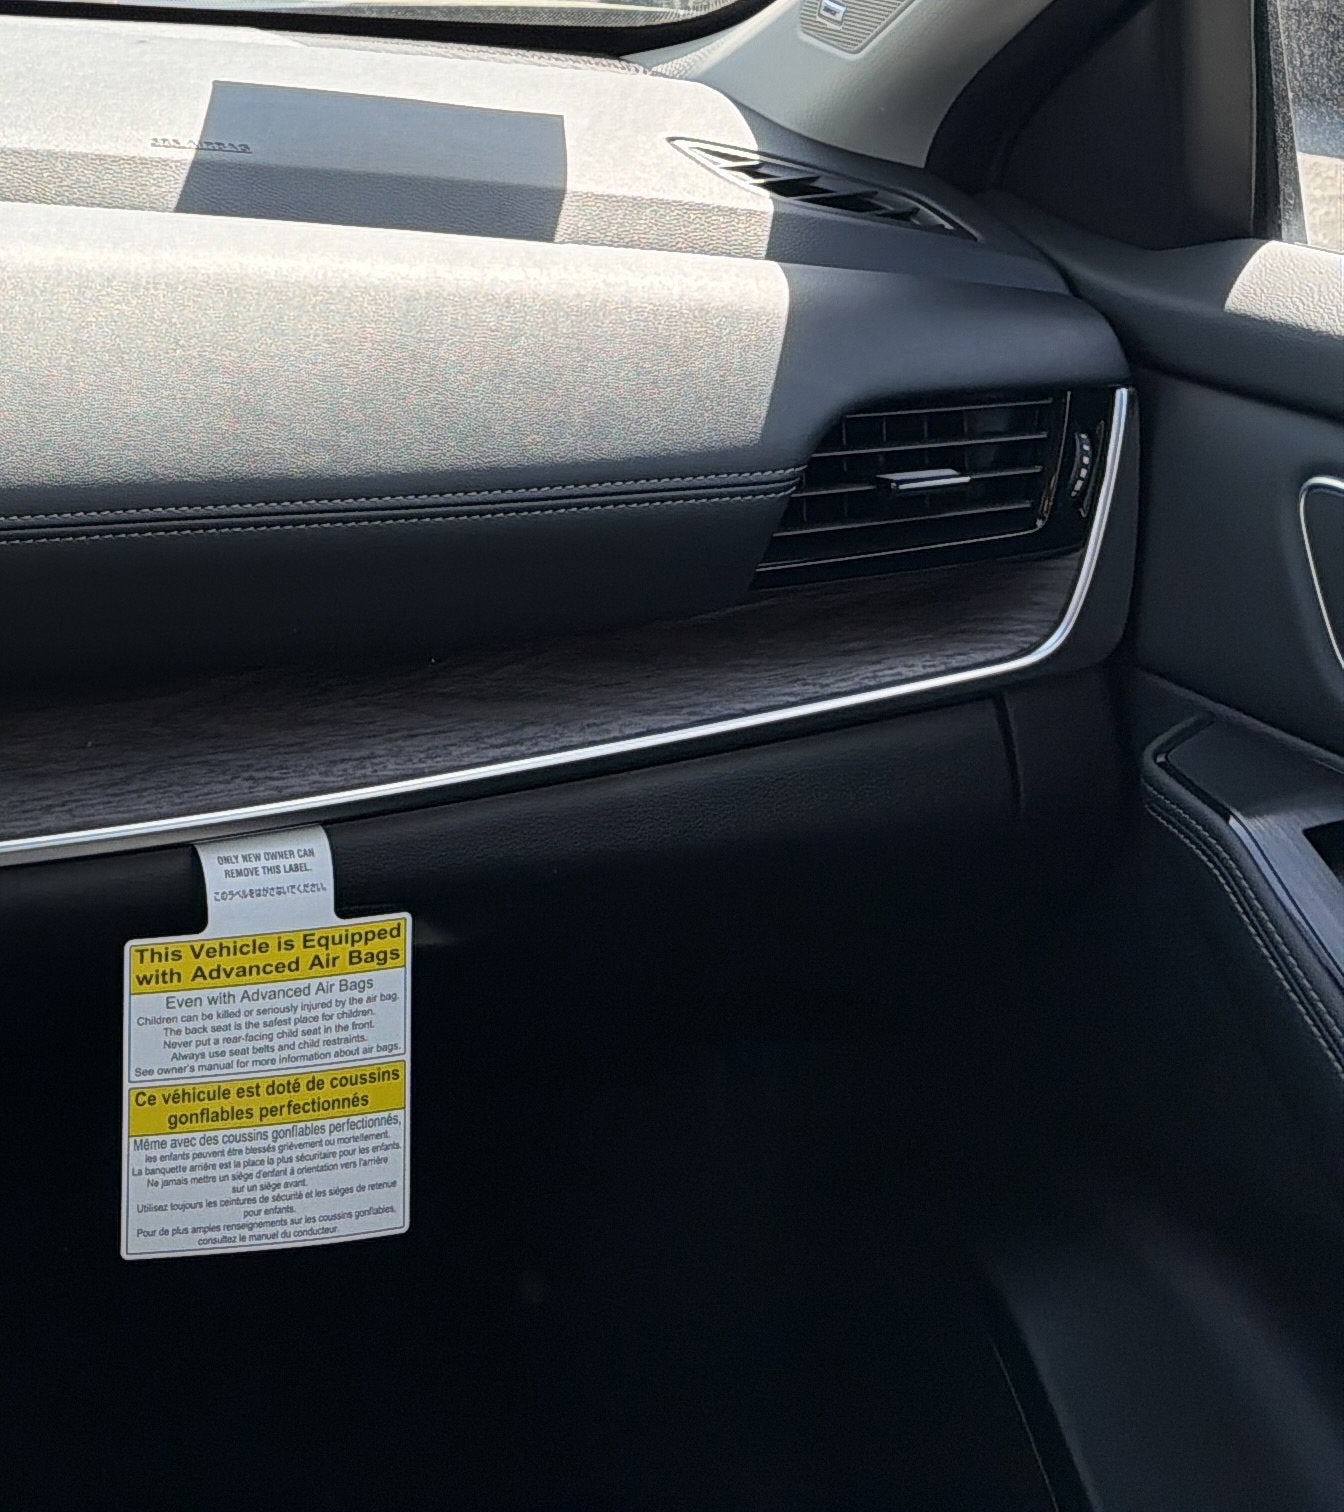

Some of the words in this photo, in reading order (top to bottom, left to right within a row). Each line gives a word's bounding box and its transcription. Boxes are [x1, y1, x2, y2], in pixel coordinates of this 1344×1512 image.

[217, 855, 239, 865] ONLY
[241, 853, 261, 863] NEW
[264, 850, 295, 861] OWNER
[297, 848, 315, 858] CAN
[224, 867, 259, 878] REMOVE
[262, 865, 281, 875] THIS
[283, 863, 312, 873] LABEL.
[135, 947, 182, 964] This
[190, 939, 269, 959] Vehicle
[277, 936, 295, 952] is
[303, 922, 402, 950] Equipped
[136, 968, 182, 986] with
[190, 956, 300, 983] Advanced
[309, 953, 340, 970] Air
[349, 948, 400, 966] Bags
[137, 1015, 178, 1026] Children
[181, 1013, 198, 1022] can
[201, 1012, 213, 1021] be
[216, 1009, 241, 1019] killed
[244, 1009, 254, 1017] or
[256, 1004, 298, 1016] seriously
[301, 999, 332, 1013] injured
[335, 998, 347, 1008] by
[349, 996, 363, 1005] the
[366, 994, 377, 1004] air
[380, 992, 400, 1003] bag.
[166, 996, 202, 1010] Even
[207, 992, 236, 1006] with
[240, 983, 311, 1003] Advanced
[315, 981, 335, 995] Air
[339, 978, 374, 993] Bags
[164, 1027, 182, 1037] The
[185, 1025, 207, 1035] back
[211, 1023, 232, 1033] seat
[234, 1021, 242, 1030] is
[245, 1021, 260, 1029] the
[263, 1016, 291, 1028] safest
[294, 1014, 319, 1026] place
[322, 1012, 334, 1021] for
[336, 1008, 376, 1019] children.
[164, 1040, 192, 1049] Never
[195, 1037, 211, 1048] put
[214, 1037, 219, 1045] a
[222, 1033, 274, 1045] rear-facing
[277, 1029, 298, 1039] child
[301, 1027, 321, 1037] seat
[324, 1026, 332, 1034] in
[335, 1024, 349, 1033] the
[352, 1021, 375, 1030] front.
[135, 1067, 154, 1077] See
[157, 1063, 195, 1076] owner's
[198, 1060, 233, 1072] manual
[236, 1058, 249, 1068] for
[252, 1058, 276, 1067] more
[279, 1050, 331, 1064] information
[334, 1048, 360, 1058] about
[362, 1043, 374, 1054] air
[376, 1041, 401, 1053] bags.
[171, 1051, 205, 1062] Always
[208, 1050, 226, 1058] use
[229, 1048, 249, 1057] seat
[252, 1045, 275, 1054] belts
[278, 1042, 296, 1051] and
[298, 1040, 320, 1050] child
[323, 1034, 368, 1046] restraints.
[135, 1091, 157, 1107] Ce
[162, 1085, 231, 1105] véhicule
[236, 1082, 261, 1098] est
[266, 1078, 301, 1096] doté
[306, 1075, 325, 1092] de
[330, 1067, 400, 1089] coussins
[168, 1105, 254, 1129] gonflables
[259, 1092, 369, 1122] perfectionnés
[170, 1137, 196, 1148] avec
[199, 1133, 219, 1147] des
[222, 1129, 268, 1144] coussins
[271, 1123, 326, 1144] gonflables
[329, 1113, 402, 1136] perfectionnés,
